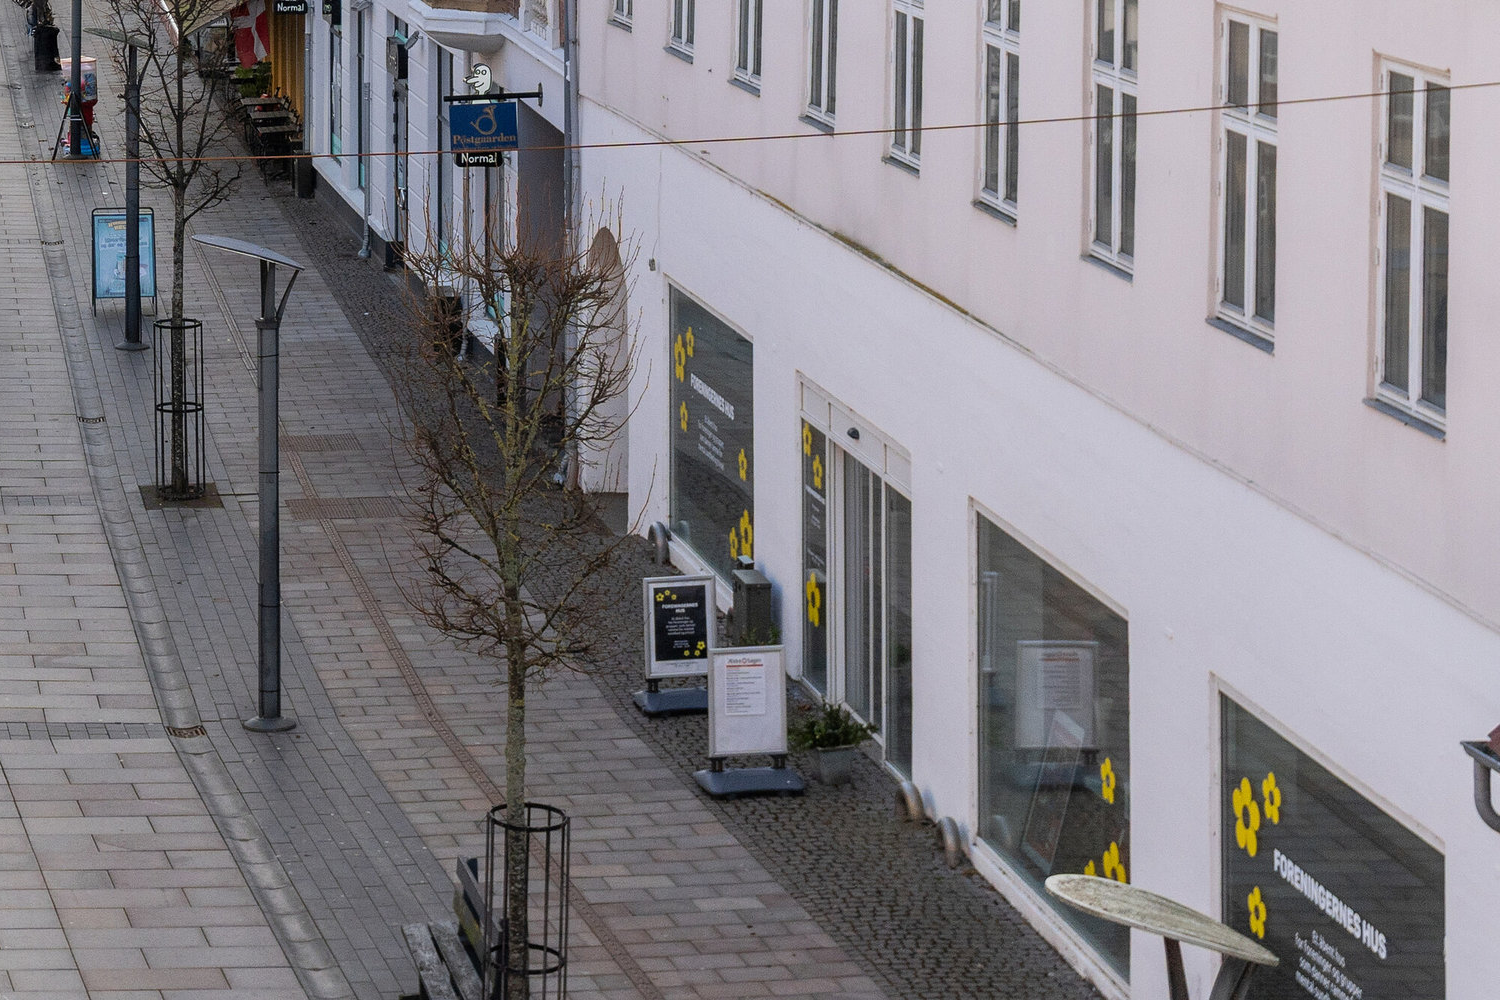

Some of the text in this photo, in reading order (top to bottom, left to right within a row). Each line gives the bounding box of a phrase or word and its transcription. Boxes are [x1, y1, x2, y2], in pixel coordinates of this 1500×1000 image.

[277, 3, 305, 12] Normal
[453, 132, 517, 146] Postgaarden
[461, 152, 498, 164] Normal
[1273, 847, 1387, 961] FORENINGERNES HUS
